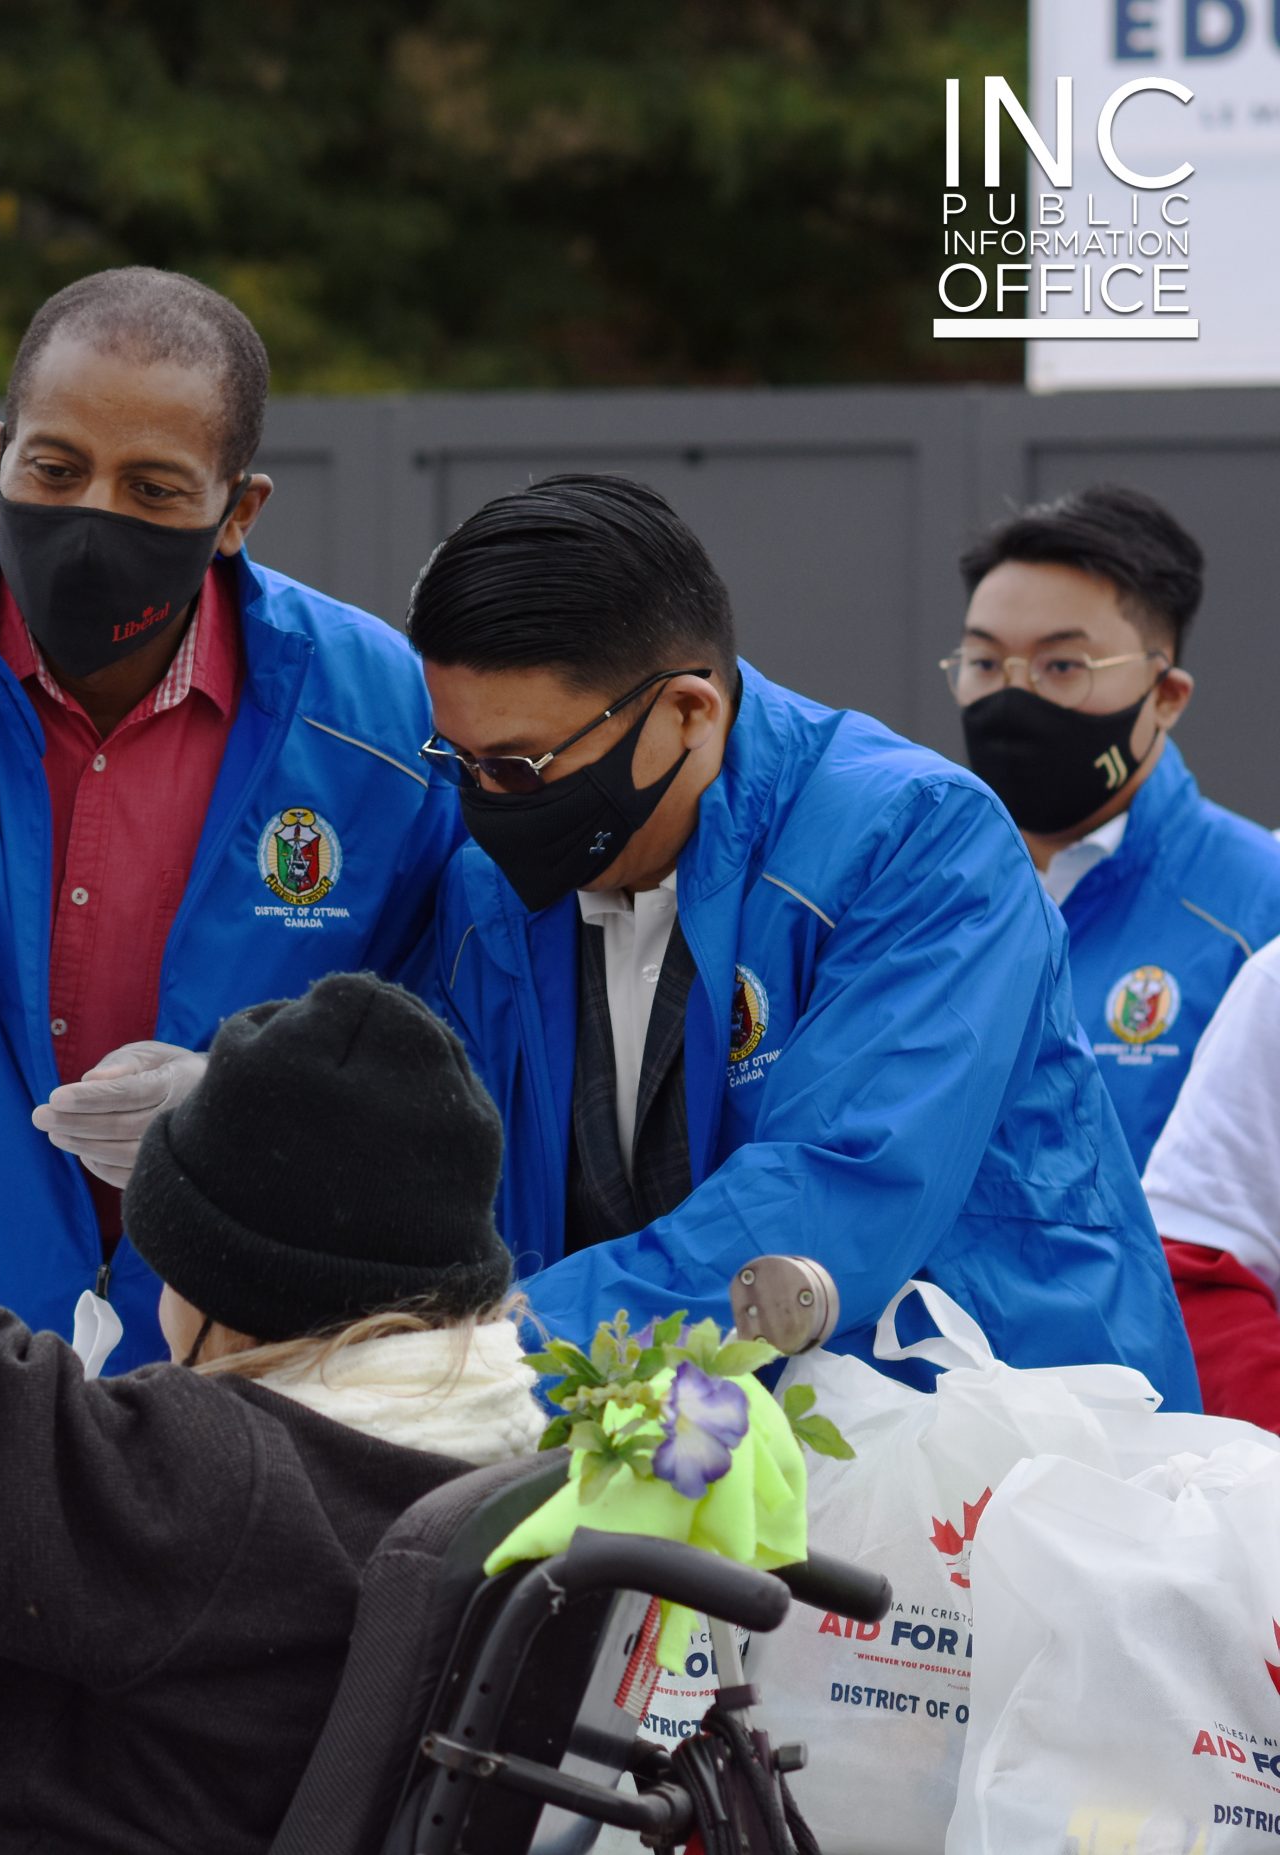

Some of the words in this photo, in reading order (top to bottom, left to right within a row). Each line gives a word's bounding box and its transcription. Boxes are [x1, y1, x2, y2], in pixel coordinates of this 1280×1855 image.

[1113, 0, 1280, 60] ED
[254, 905, 295, 917] DISTRICT
[297, 907, 310, 917] OF
[313, 907, 350, 918] OTTAWA
[284, 917, 324, 928] CANADA
[752, 1049, 783, 1068] OTTAW
[729, 1067, 765, 1088] CANADA
[911, 1604, 925, 1616] NI
[818, 1610, 881, 1642] AID
[890, 1620, 959, 1656] FOR
[901, 1660, 918, 1669] YOU
[919, 1664, 955, 1675] POSSIBLY
[830, 1682, 921, 1714] DISTRICT
[926, 1699, 950, 1720] OF
[1214, 1721, 1258, 1744] IGLESIA
[1264, 1738, 1278, 1747] NI
[1192, 1729, 1247, 1763] AID
